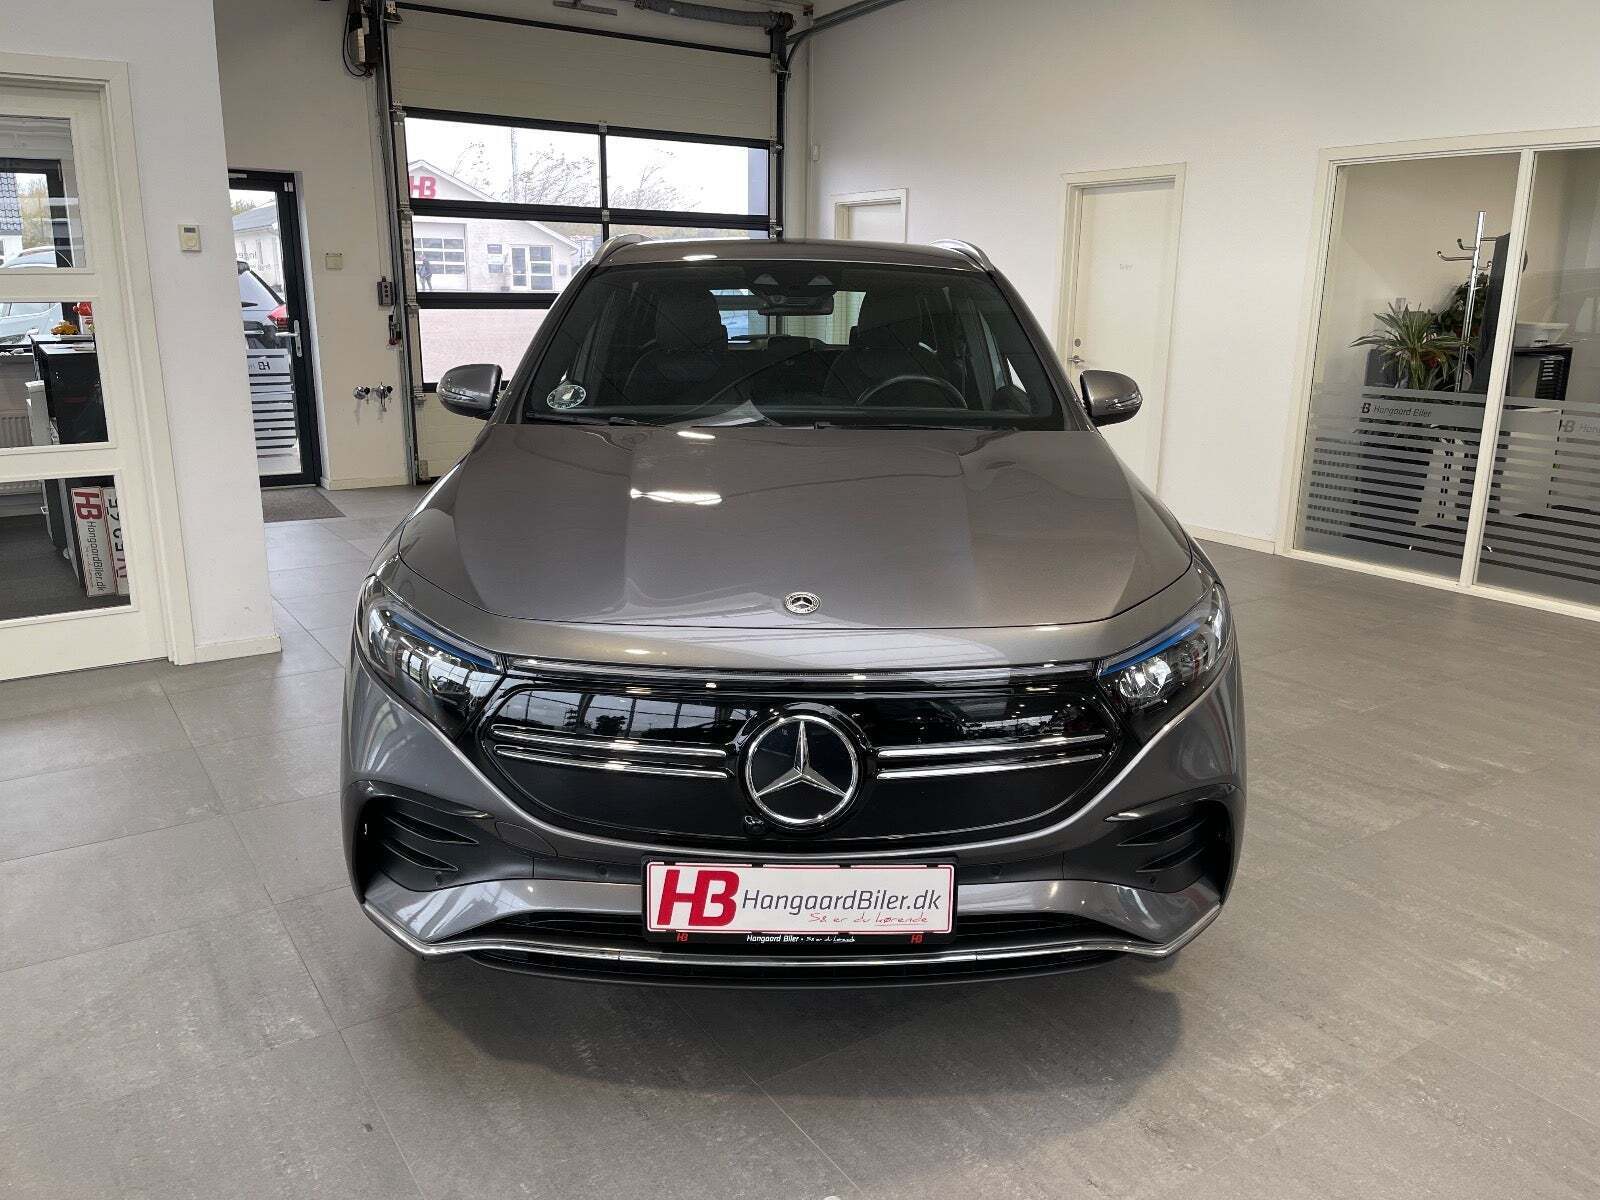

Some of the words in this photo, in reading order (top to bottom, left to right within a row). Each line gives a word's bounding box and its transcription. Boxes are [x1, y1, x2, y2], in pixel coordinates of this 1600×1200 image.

[411, 176, 436, 198] HB
[73, 491, 103, 520] HB
[656, 869, 740, 926] HB
[742, 889, 942, 916] HangaardBiler.dk
[676, 933, 689, 942] HB
[746, 935, 782, 944] Hangaard
[783, 935, 800, 943] Biler
